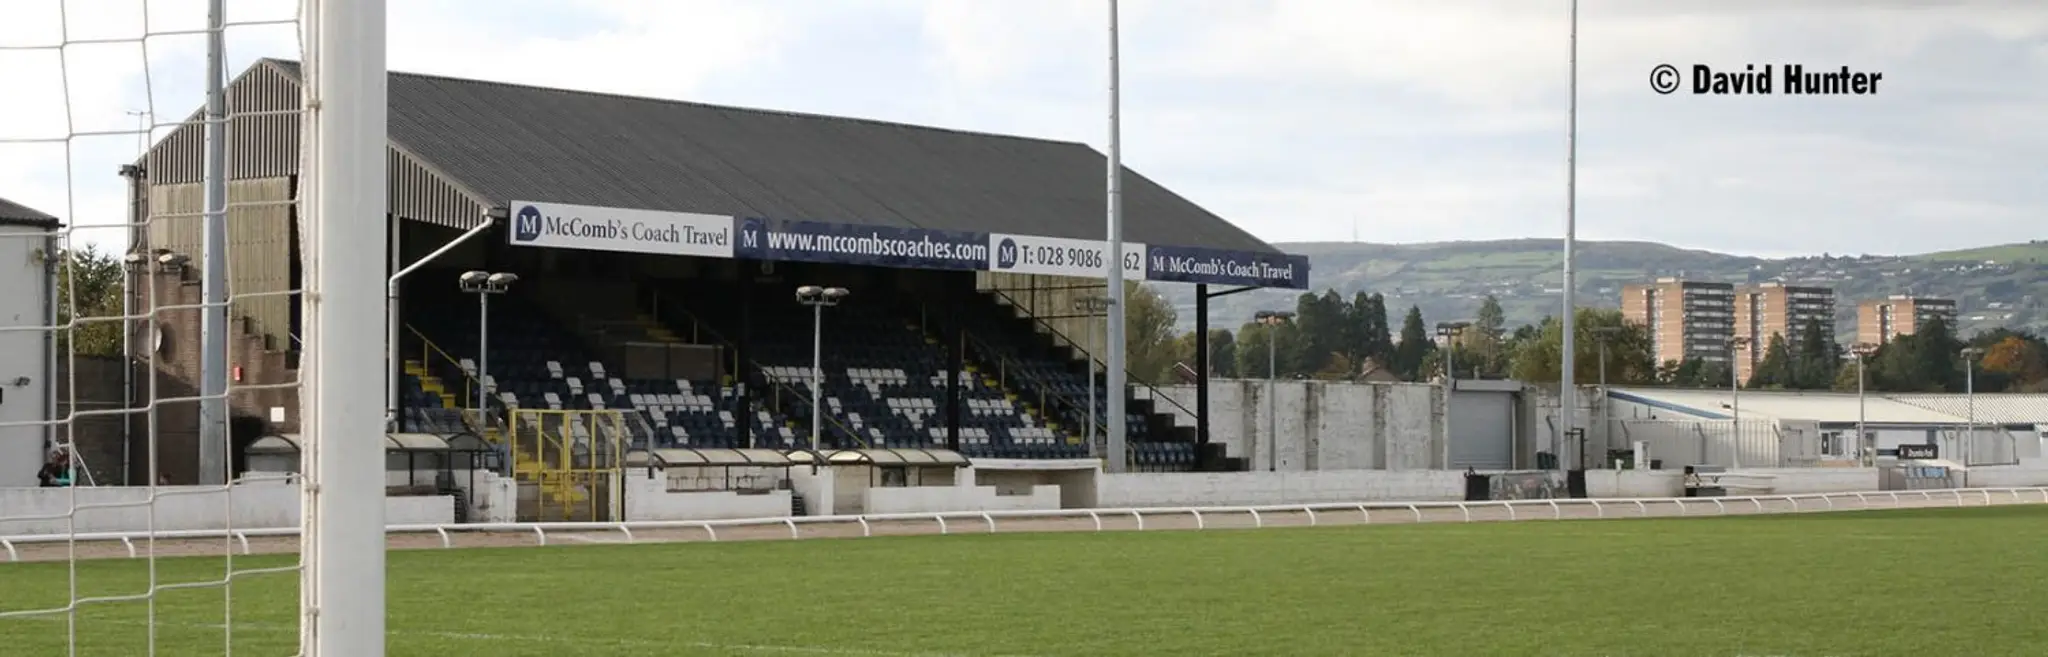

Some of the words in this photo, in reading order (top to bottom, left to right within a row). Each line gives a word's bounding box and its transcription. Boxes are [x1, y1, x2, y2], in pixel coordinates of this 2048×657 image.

[520, 214, 537, 234] M
[545, 215, 628, 240] McComb's
[632, 221, 680, 243] Coach
[683, 225, 728, 246] Travel
[743, 229, 758, 249] M
[767, 231, 987, 261] www.mccombscoaches.com
[1001, 245, 1014, 263] M
[1022, 245, 1034, 264] T:
[1037, 246, 1064, 266] 028
[1067, 247, 1103, 268] 9086
[1152, 255, 1164, 272] M
[1169, 256, 1226, 276] McComb's
[1227, 260, 1260, 278] Coach
[1261, 262, 1293, 280] Travel
